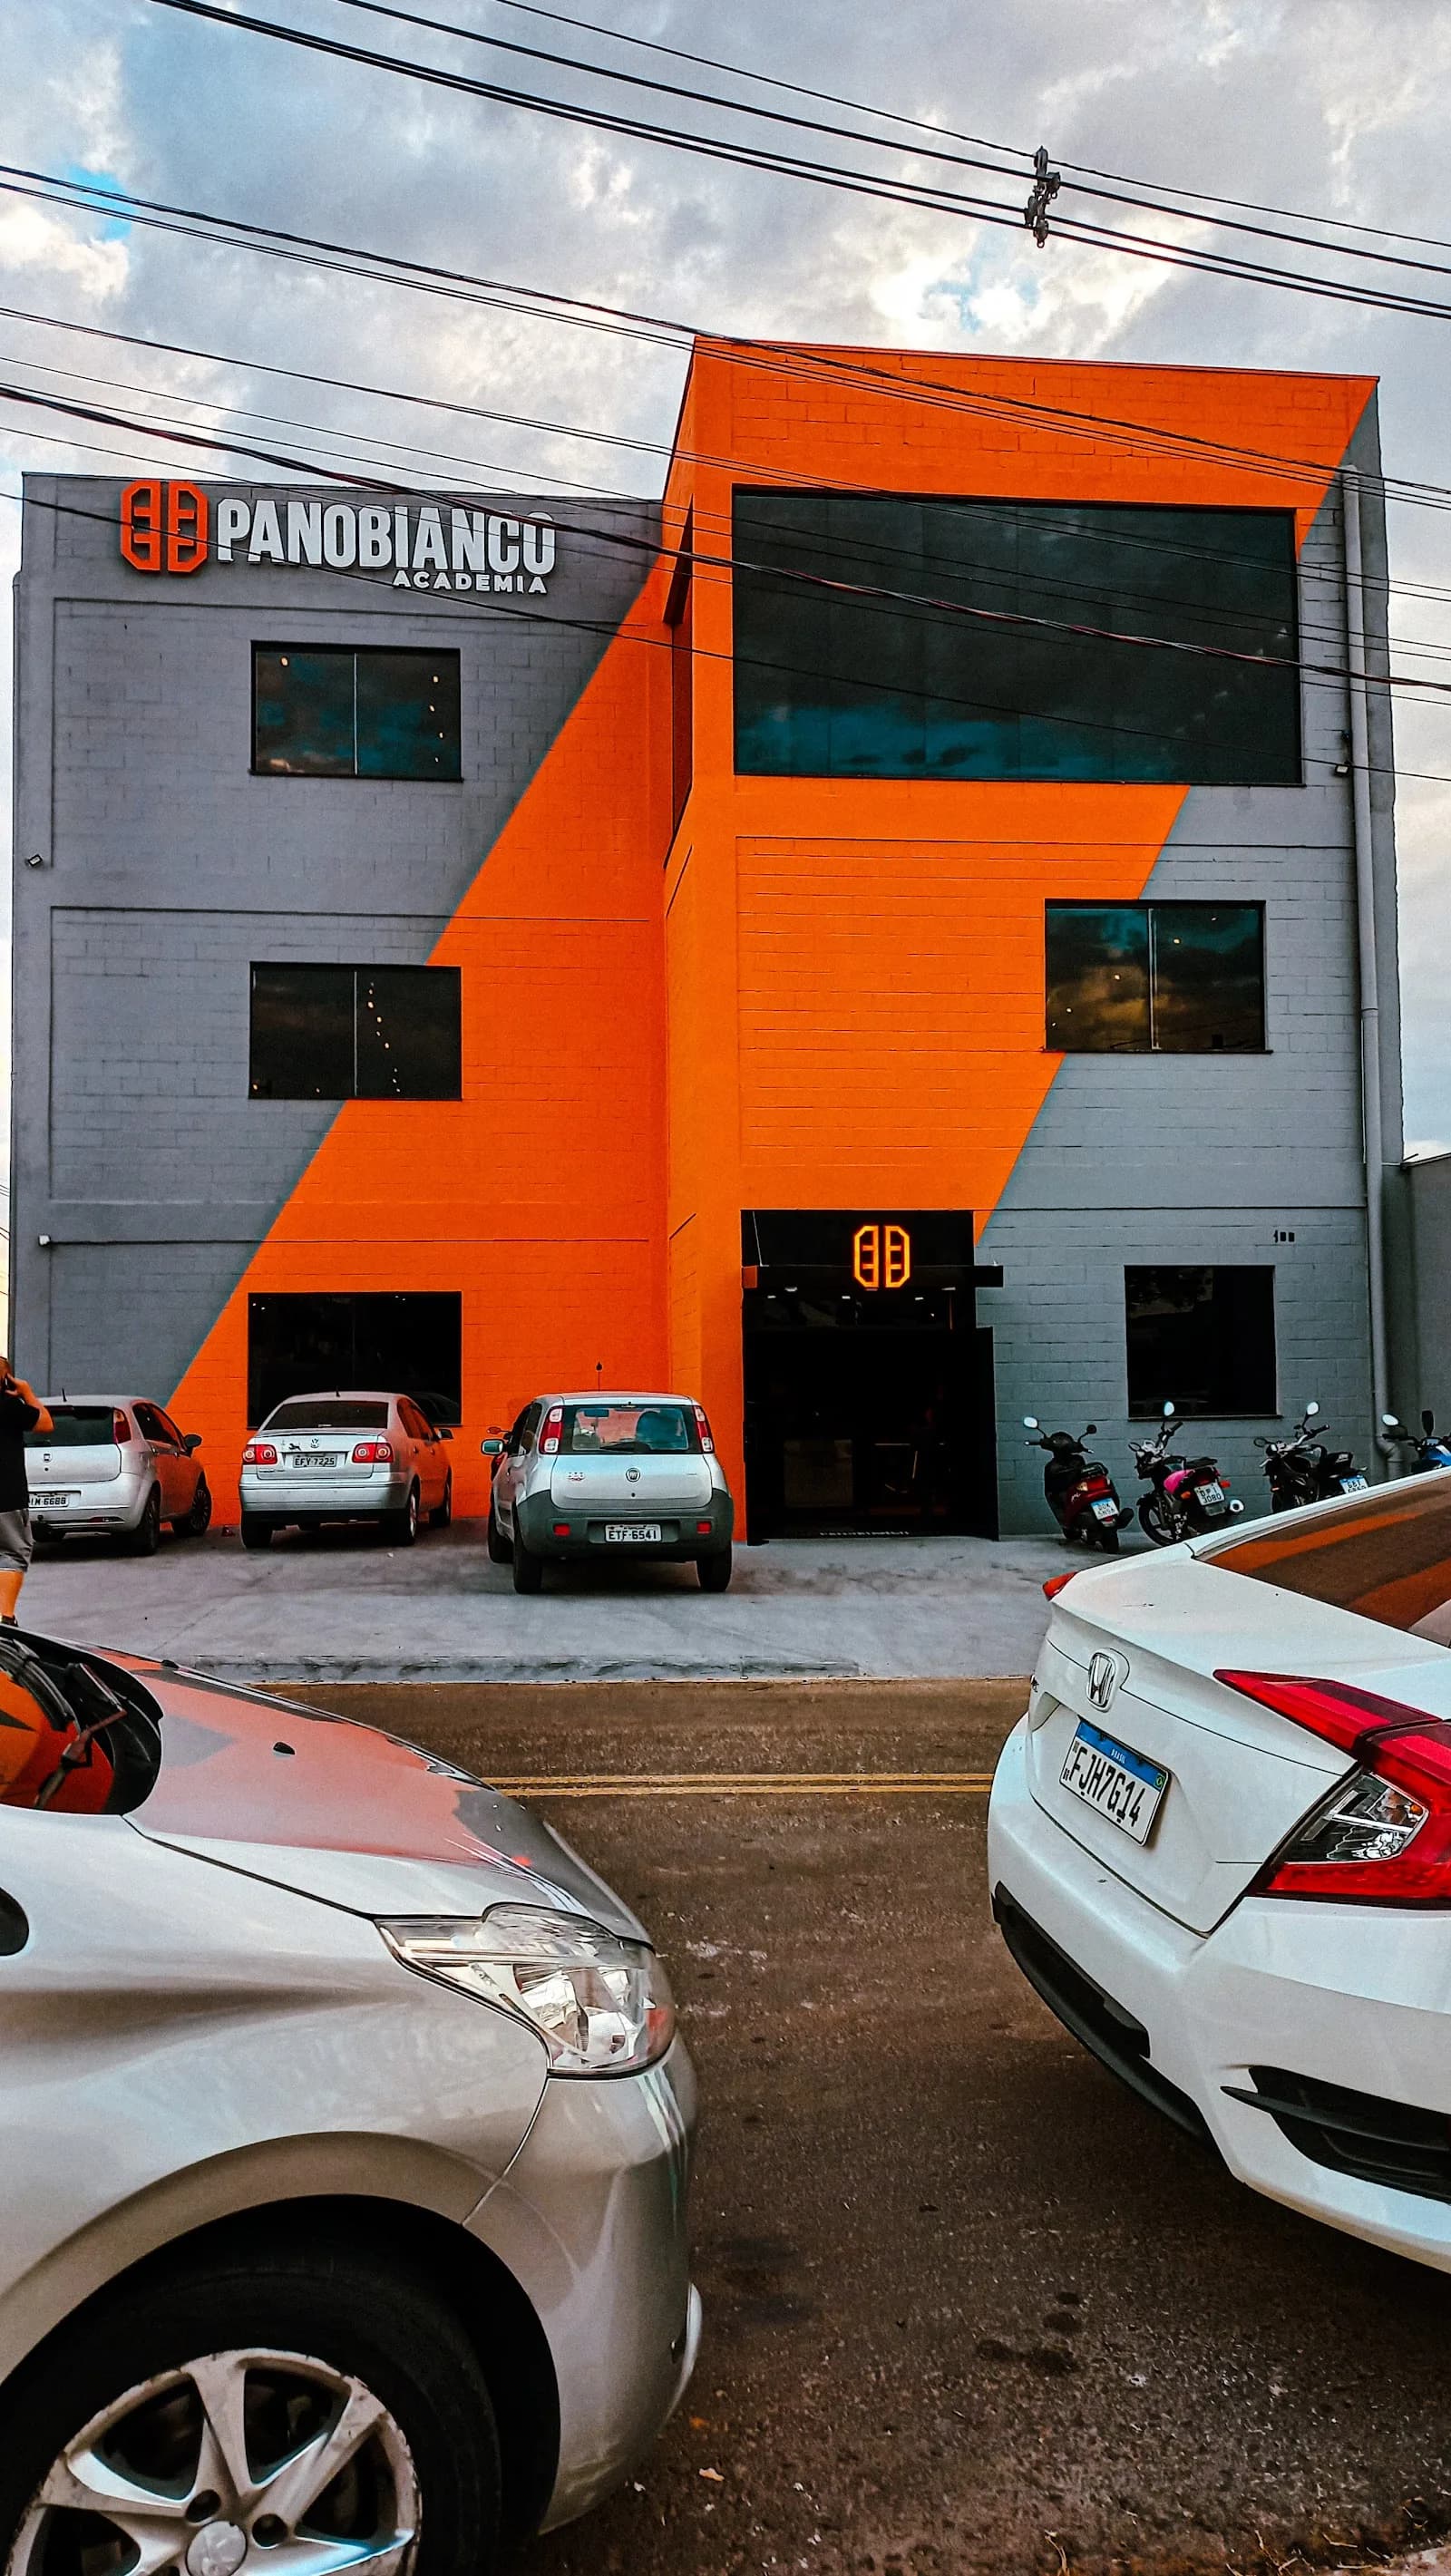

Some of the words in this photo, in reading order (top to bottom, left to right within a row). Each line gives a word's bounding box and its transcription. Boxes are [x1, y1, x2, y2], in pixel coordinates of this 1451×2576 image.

[217, 498, 556, 575] PANOBIANCO
[393, 570, 548, 594] ACADEMIA
[1069, 1746, 1146, 1827] FJH7G14
